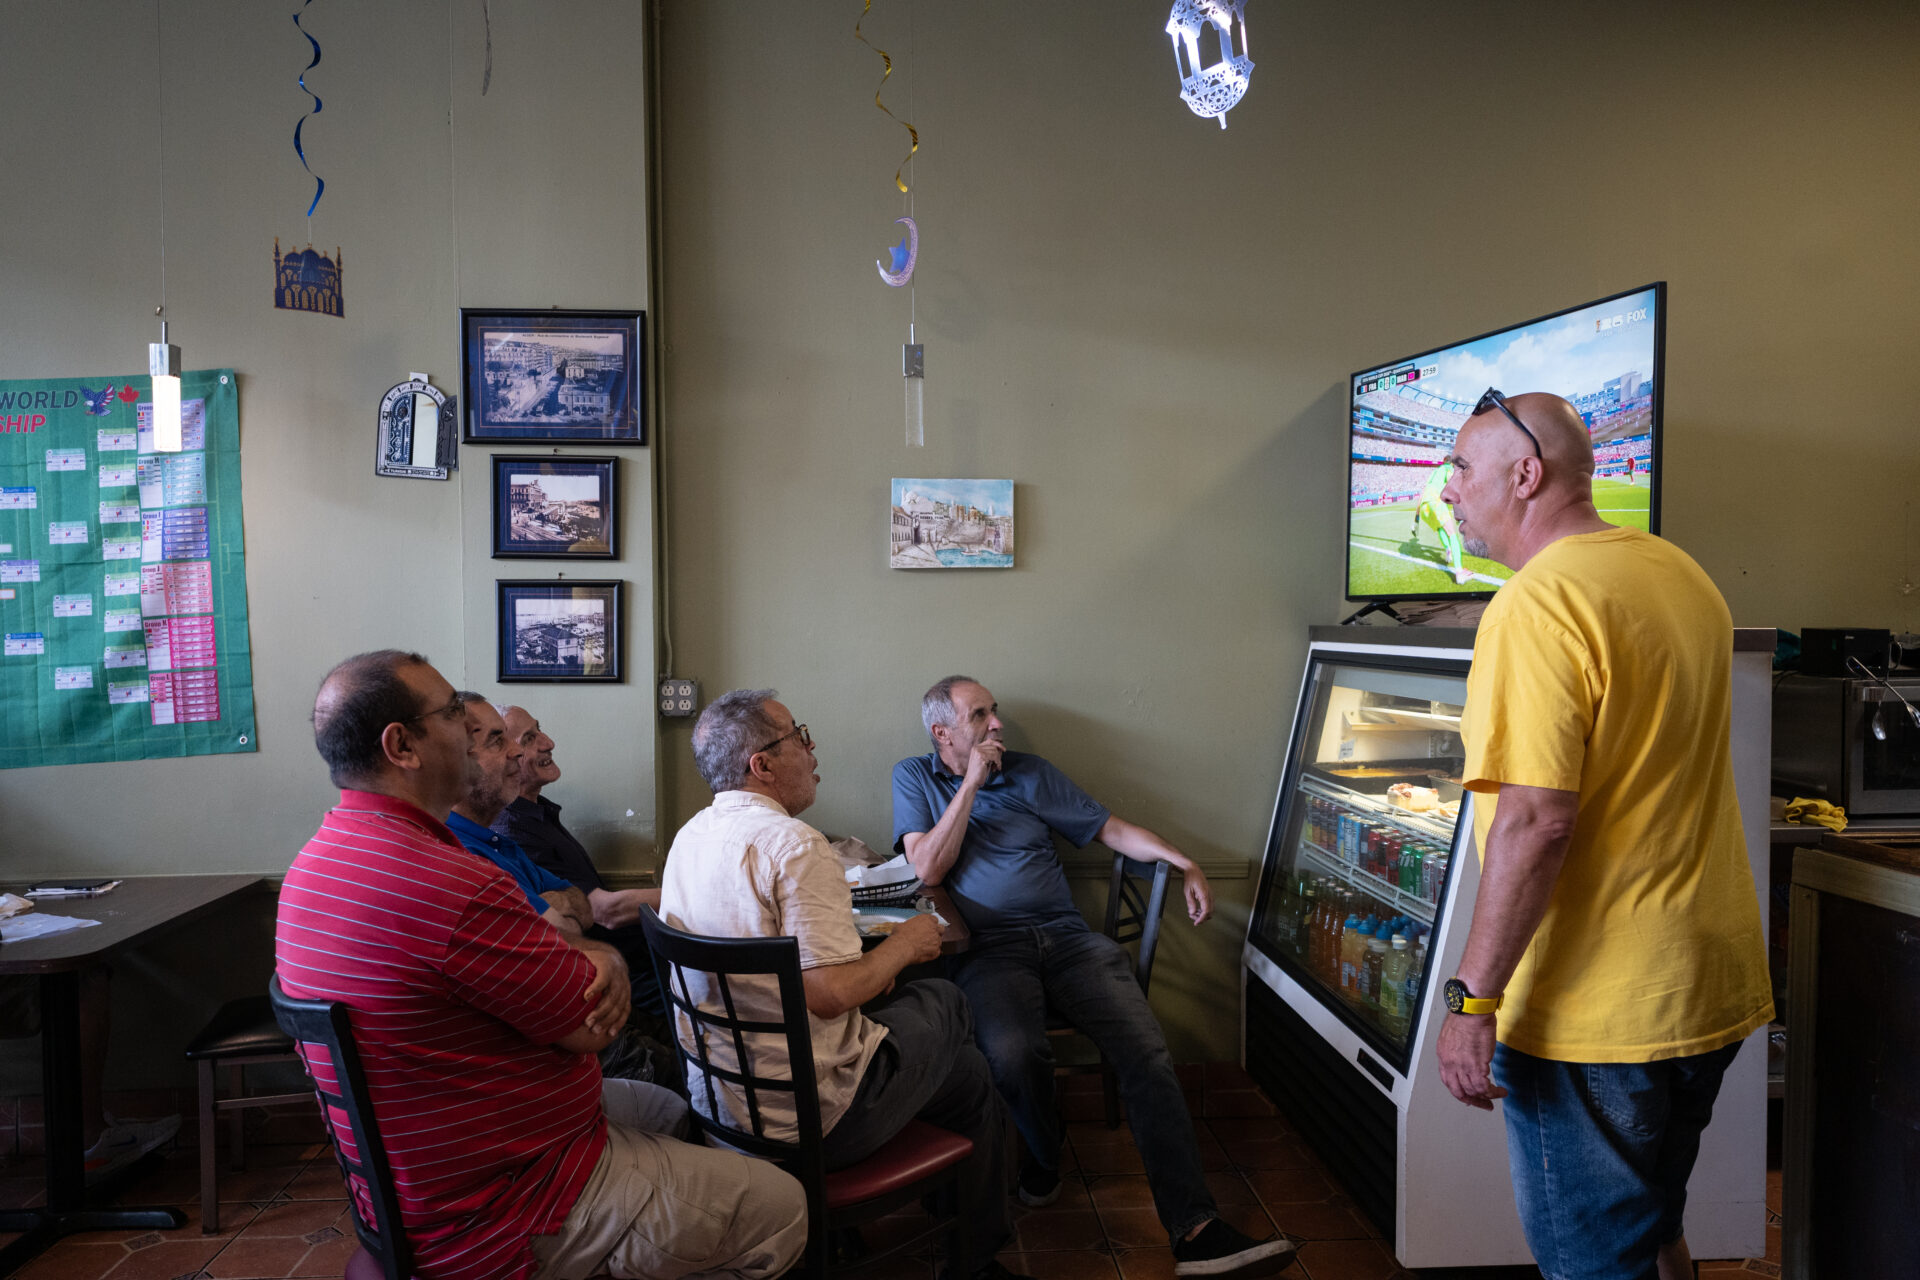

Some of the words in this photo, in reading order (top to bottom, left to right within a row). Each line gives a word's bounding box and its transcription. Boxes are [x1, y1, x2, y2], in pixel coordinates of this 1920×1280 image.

[1627, 308, 1647, 324] FOX
[1422, 367, 1437, 377] 27:59
[0, 391, 78, 409] WORLD
